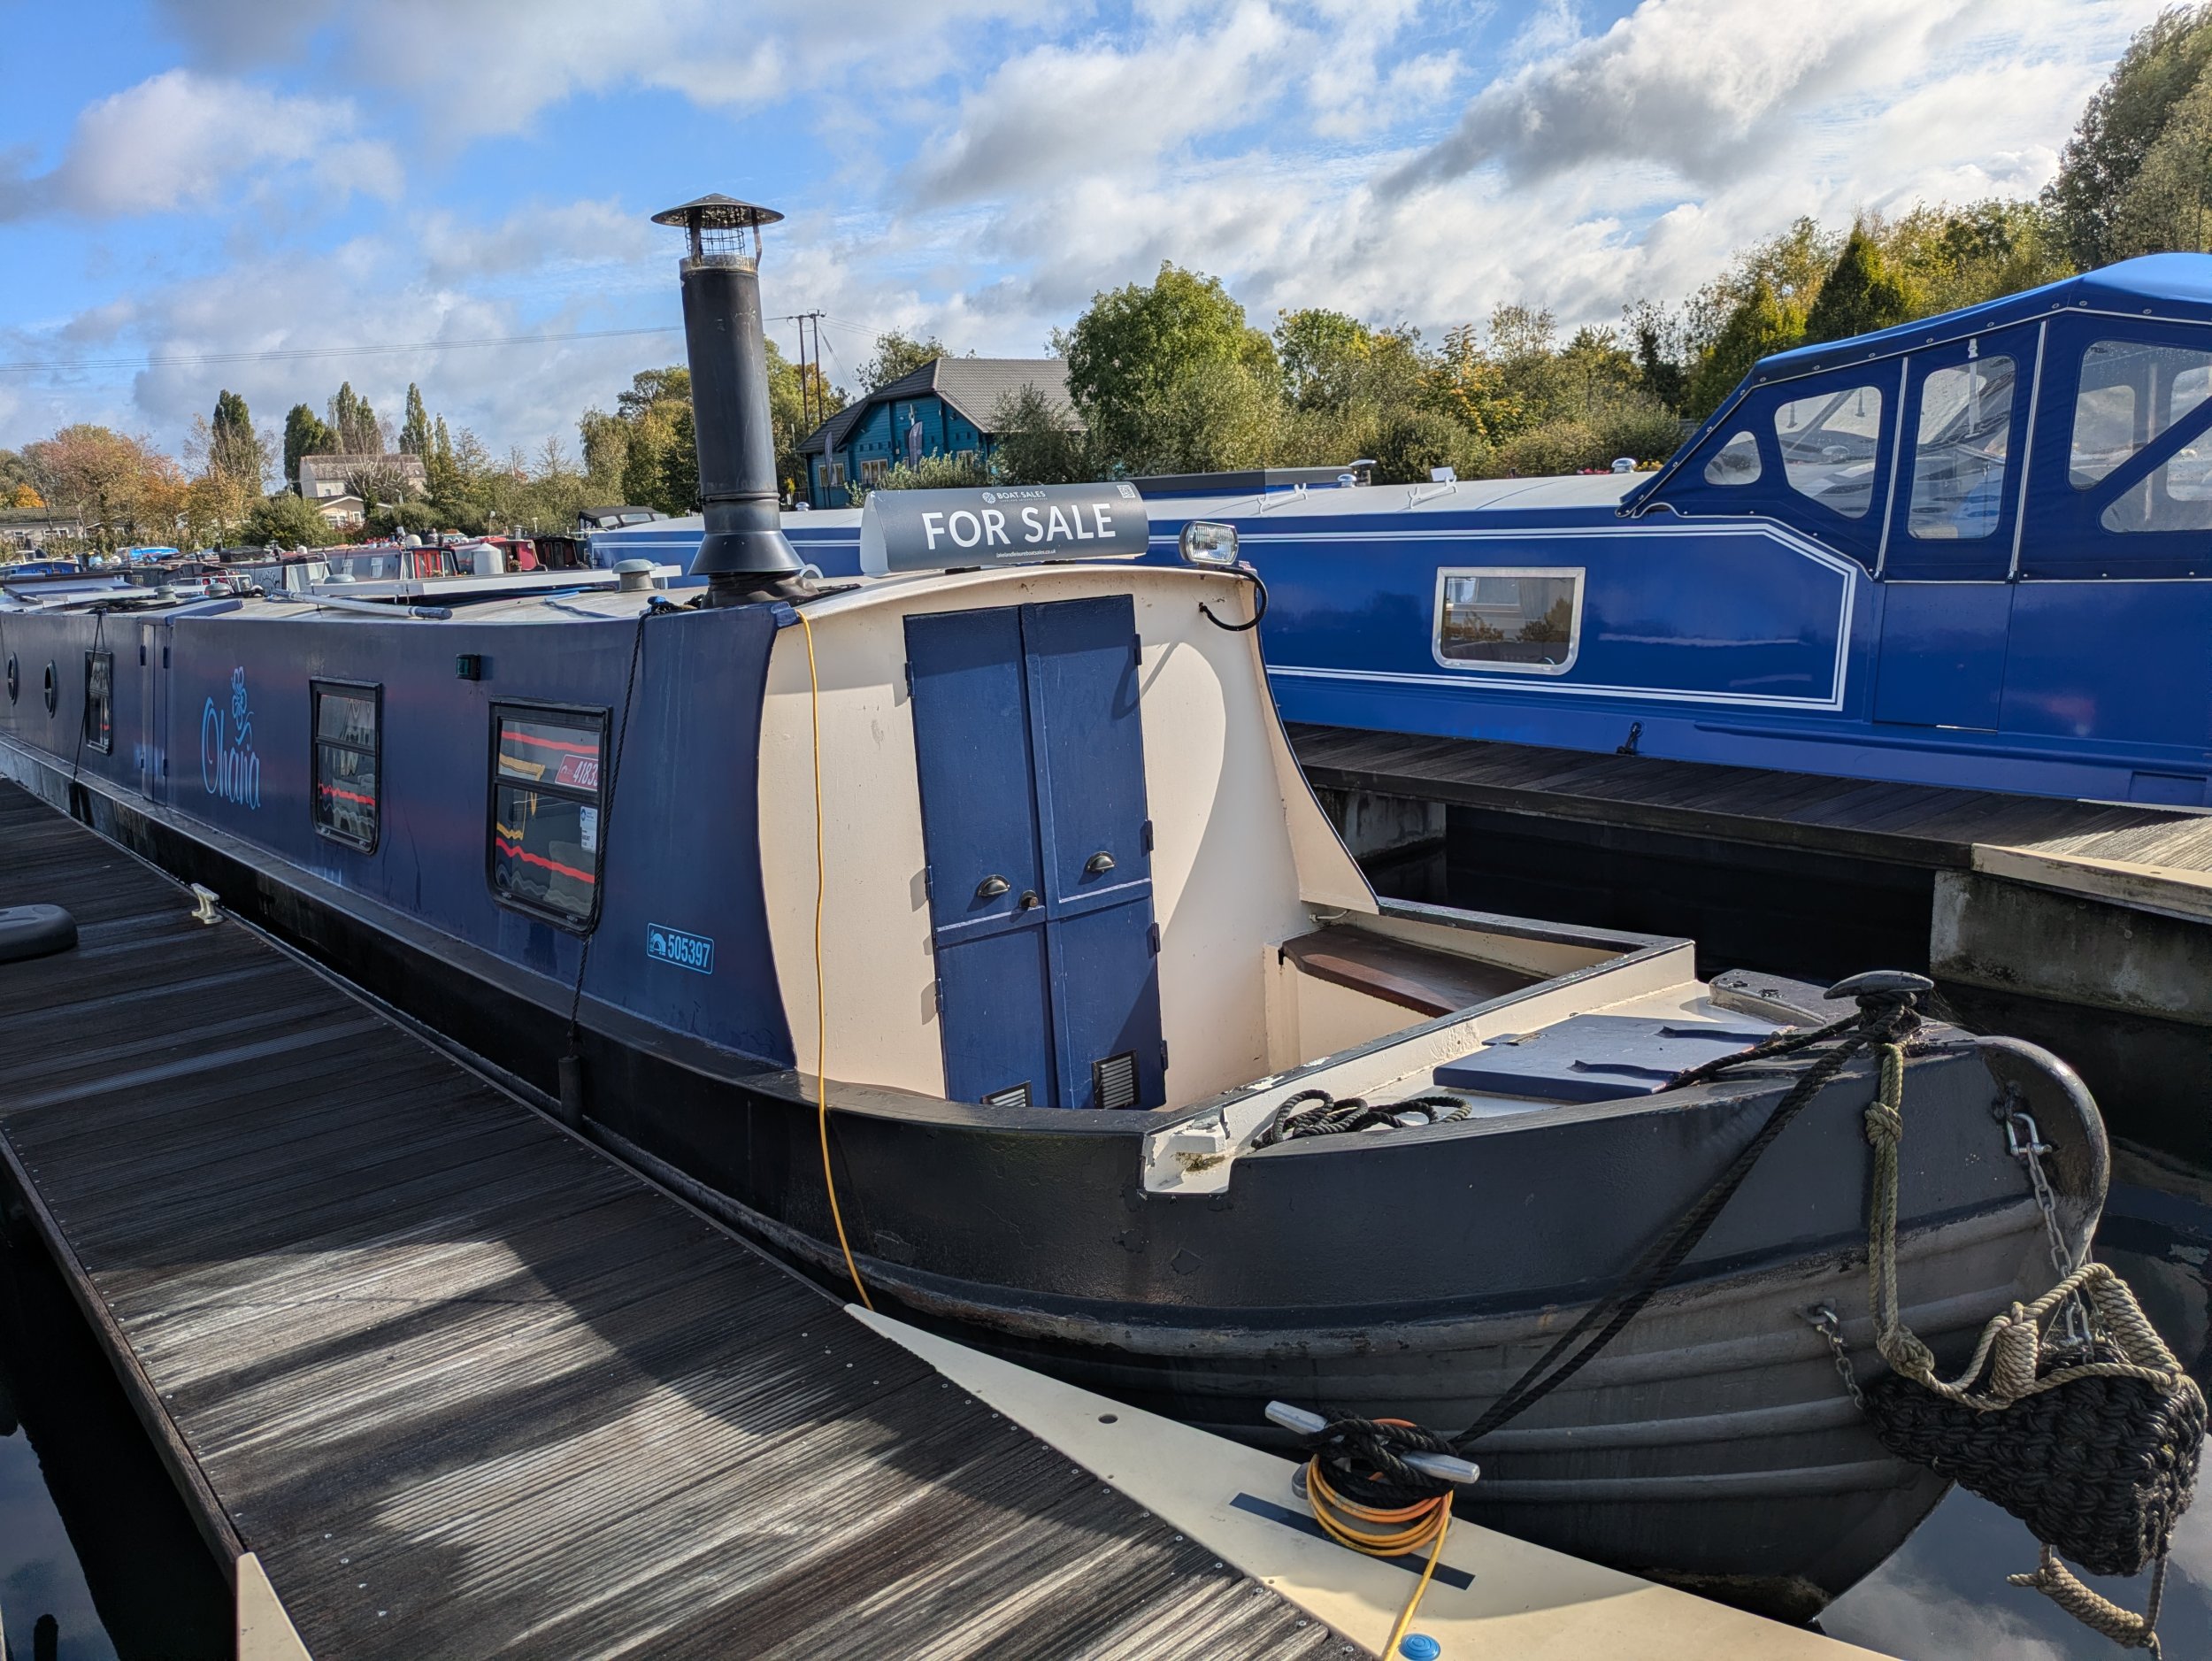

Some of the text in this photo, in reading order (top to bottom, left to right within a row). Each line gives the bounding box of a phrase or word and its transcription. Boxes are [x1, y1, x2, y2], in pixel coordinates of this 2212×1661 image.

[921, 503, 1117, 550] FOR SALE
[201, 696, 261, 811] Ohana
[667, 934, 710, 968] 505397
